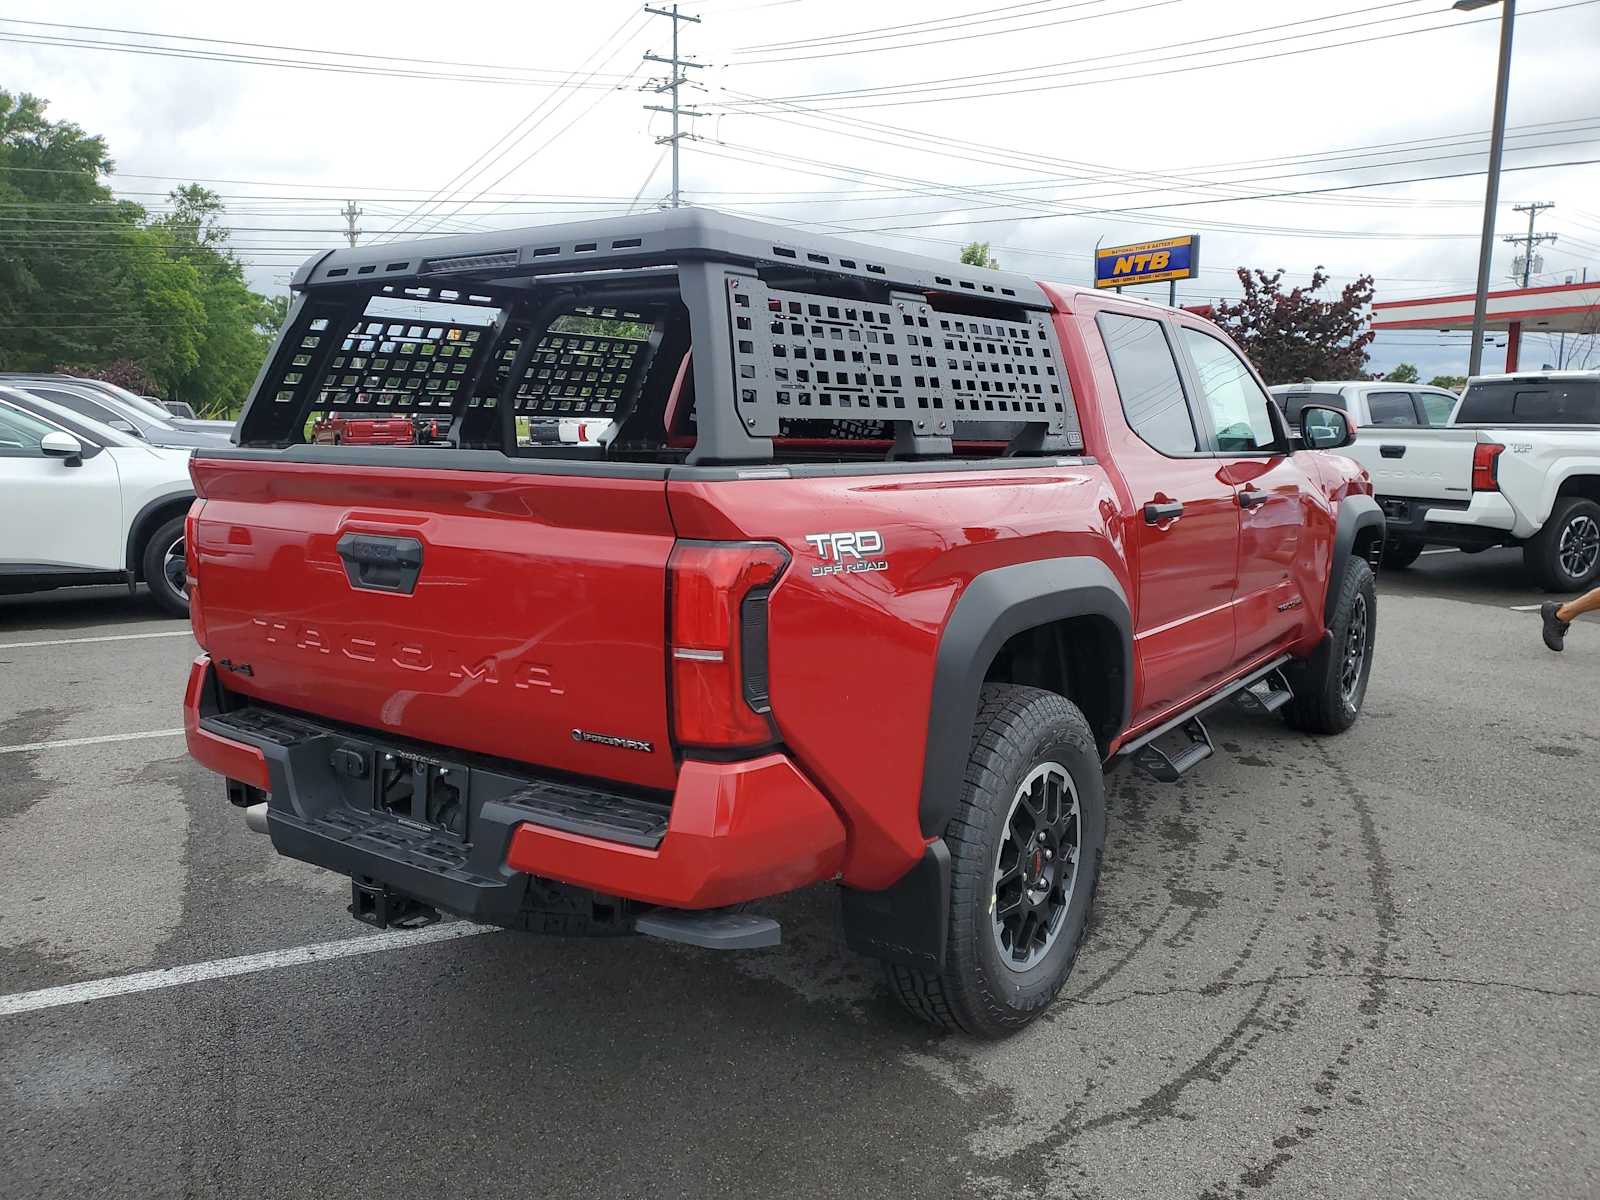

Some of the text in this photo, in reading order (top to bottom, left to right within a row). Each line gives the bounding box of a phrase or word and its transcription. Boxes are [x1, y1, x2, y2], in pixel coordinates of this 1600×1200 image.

[1113, 251, 1171, 275] NTB
[805, 531, 883, 560] TRD
[811, 560, 889, 577] OFF ROAD
[252, 617, 565, 695] TACOMA
